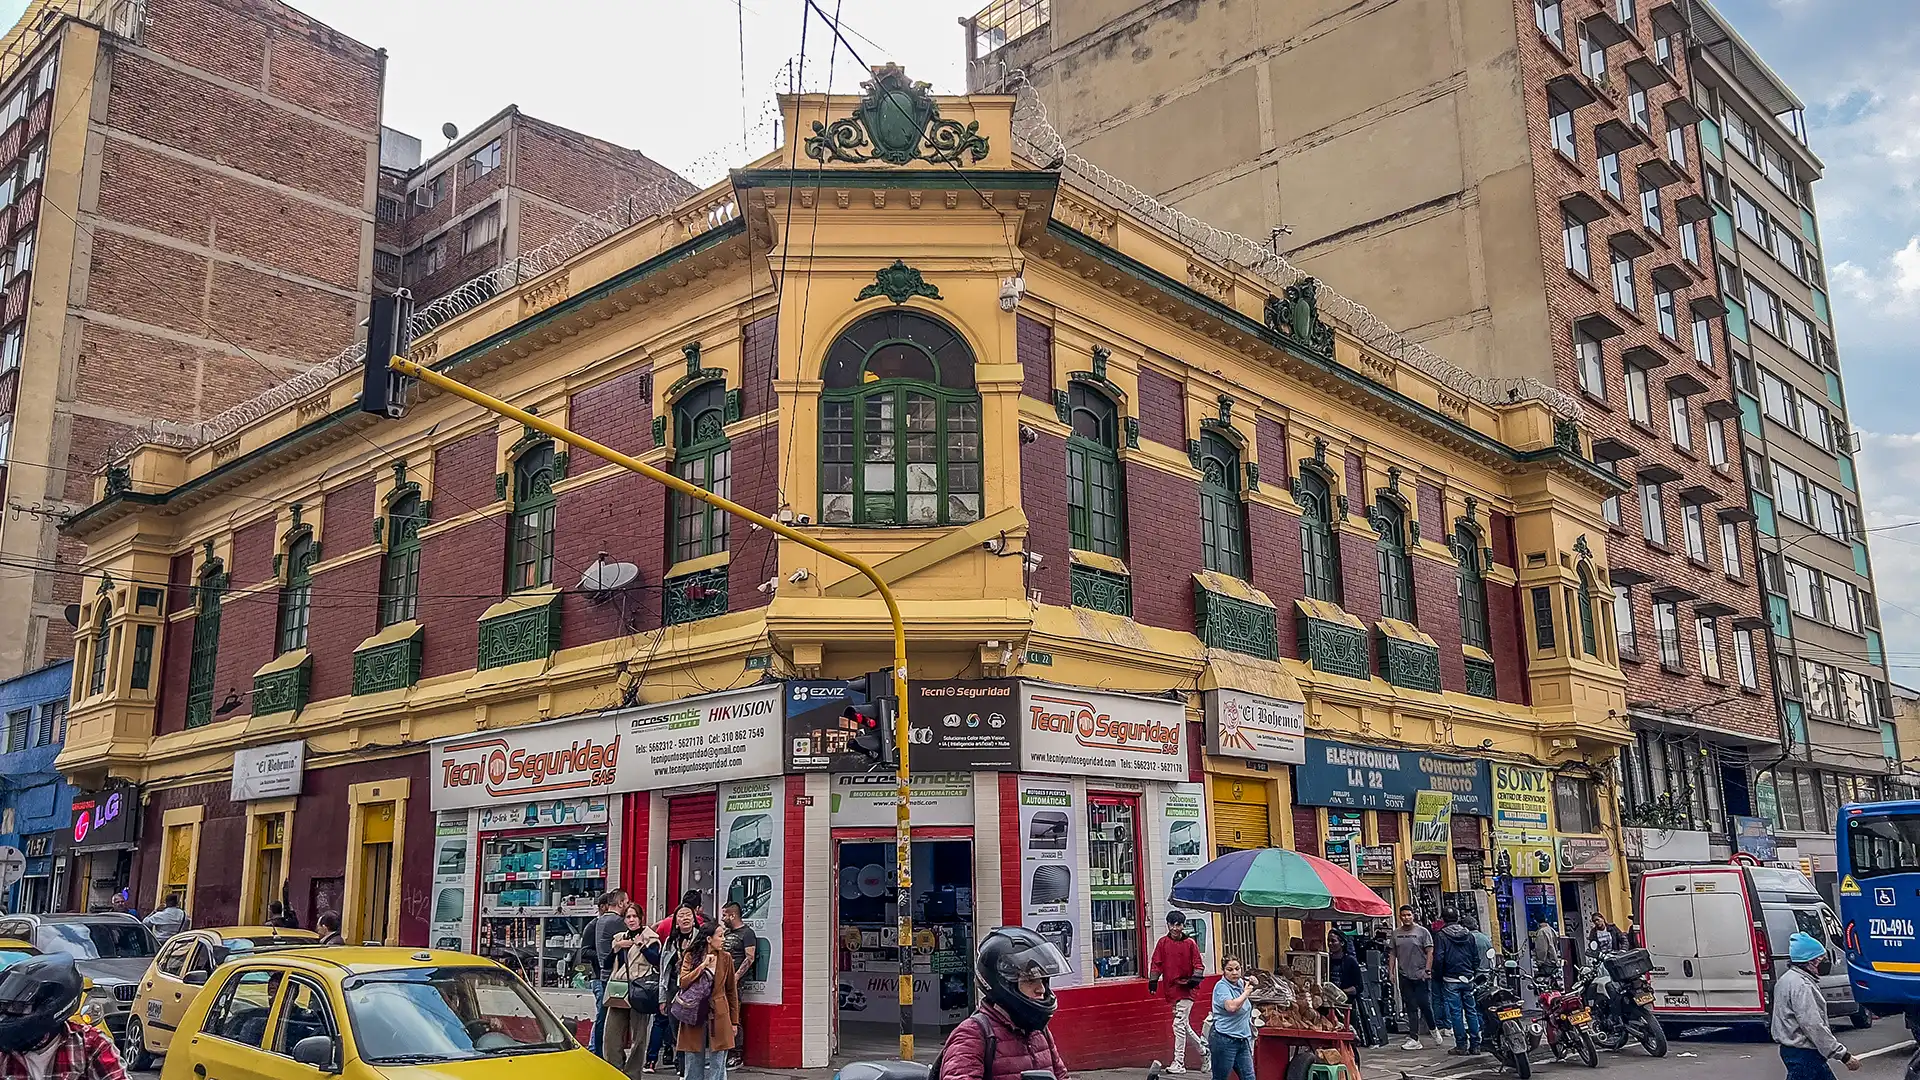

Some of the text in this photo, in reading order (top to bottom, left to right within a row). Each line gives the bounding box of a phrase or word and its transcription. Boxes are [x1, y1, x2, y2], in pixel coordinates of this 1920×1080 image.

[1031, 652, 1049, 664] CL 22
[810, 687, 845, 696] EZVIZ
[920, 687, 1011, 699] Tecni Seguridad
[631, 700, 774, 727] accessmatic HIKVISION
[722, 732, 733, 742] 310
[735, 730, 747, 740] 862
[1030, 705, 1076, 733] Tecni
[1095, 719, 1181, 744] Seguridad
[1161, 743, 1178, 755] SAS
[442, 754, 487, 788] Tecni
[507, 734, 621, 784] Seguridad
[591, 769, 616, 786] SAS
[1326, 746, 1400, 771] ELECTRONICA
[1419, 756, 1477, 777] CONTROLES
[1347, 767, 1384, 790] LA 22
[1430, 776, 1472, 792] REMOTO
[1497, 766, 1545, 792] SONY
[733, 783, 771, 794] SOLUCIONES
[853, 790, 884, 798] MOTORES
[1026, 796, 1066, 805] AUTOMÁTICAS
[1362, 794, 1376, 806] 9-11
[1497, 792, 1516, 800] CENTRO
[1516, 793, 1522, 801] DE
[728, 800, 771, 811] AUTOMÁTICAS
[1385, 799, 1404, 808] SONY
[94, 792, 120, 830] LG
[1869, 919, 1914, 936] Z70-4916
